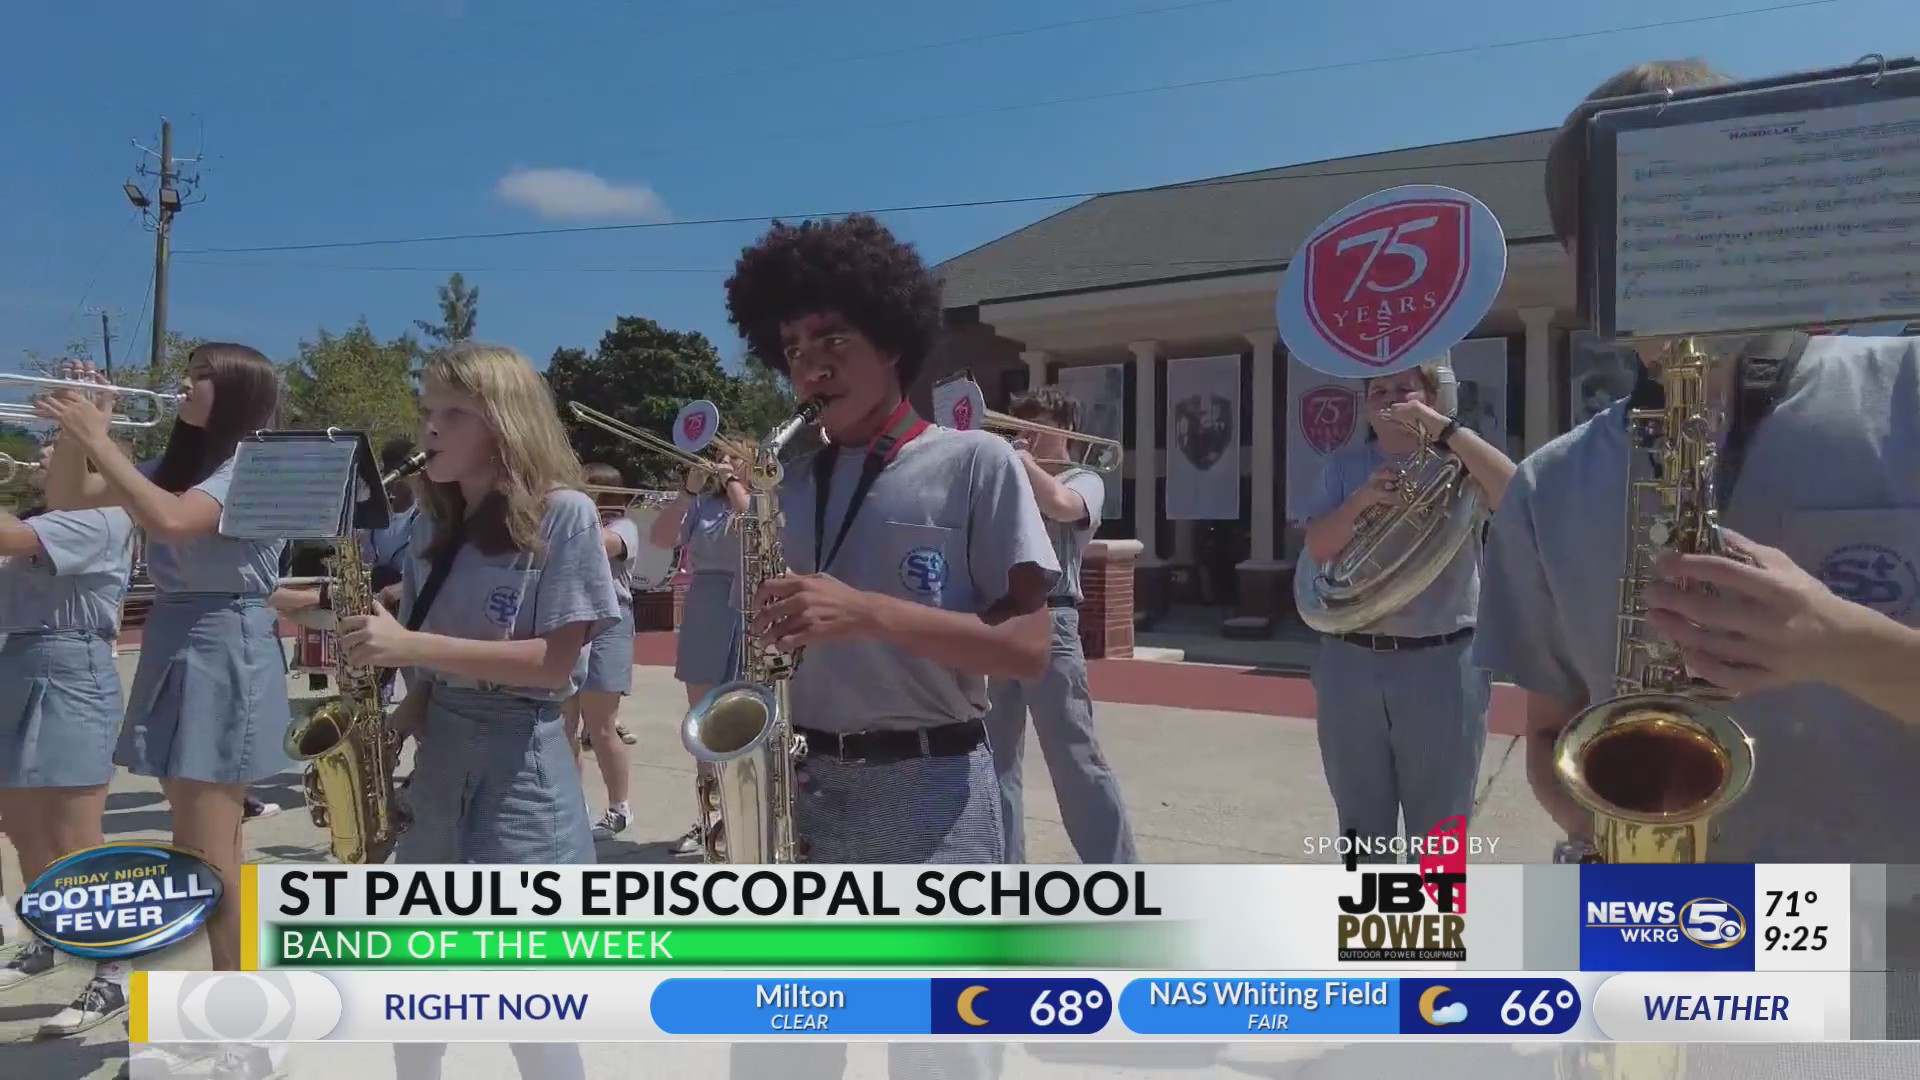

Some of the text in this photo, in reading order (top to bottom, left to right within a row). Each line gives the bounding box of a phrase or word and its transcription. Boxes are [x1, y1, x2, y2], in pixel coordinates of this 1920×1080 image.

[1336, 215, 1439, 303] 75
[1333, 291, 1436, 327] YEARS
[1312, 396, 1347, 424] 75
